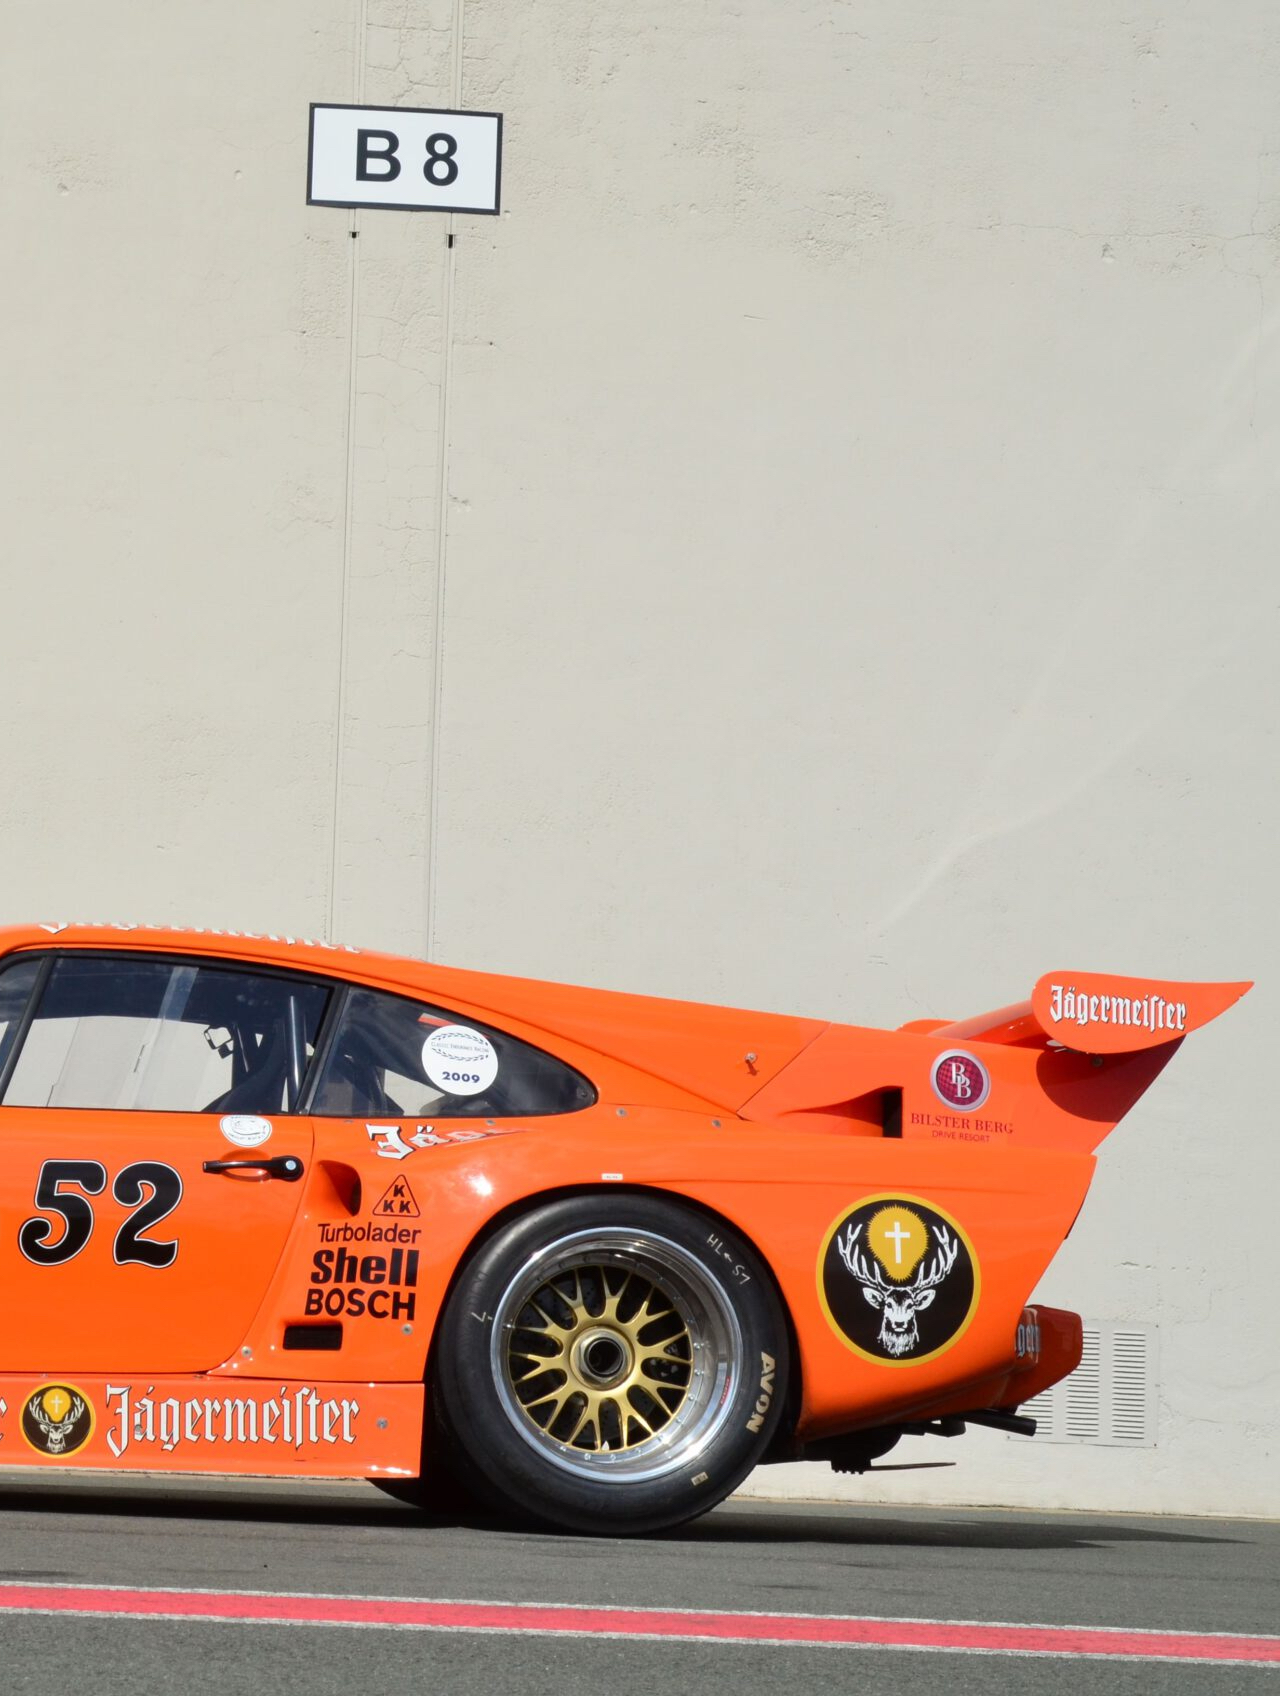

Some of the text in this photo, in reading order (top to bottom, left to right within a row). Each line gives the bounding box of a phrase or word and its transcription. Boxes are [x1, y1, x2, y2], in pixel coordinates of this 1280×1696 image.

[356, 129, 458, 186] B 8
[442, 1071, 480, 1083] 2009
[911, 1113, 1014, 1134] BILSTER BERG
[932, 1130, 990, 1142] DRIVE RESORT
[18, 1159, 183, 1269] 52
[318, 1221, 421, 1244] Turbolader
[310, 1247, 419, 1287] Shell
[304, 1287, 416, 1321] BOSCH
[745, 1351, 776, 1434] AVON
